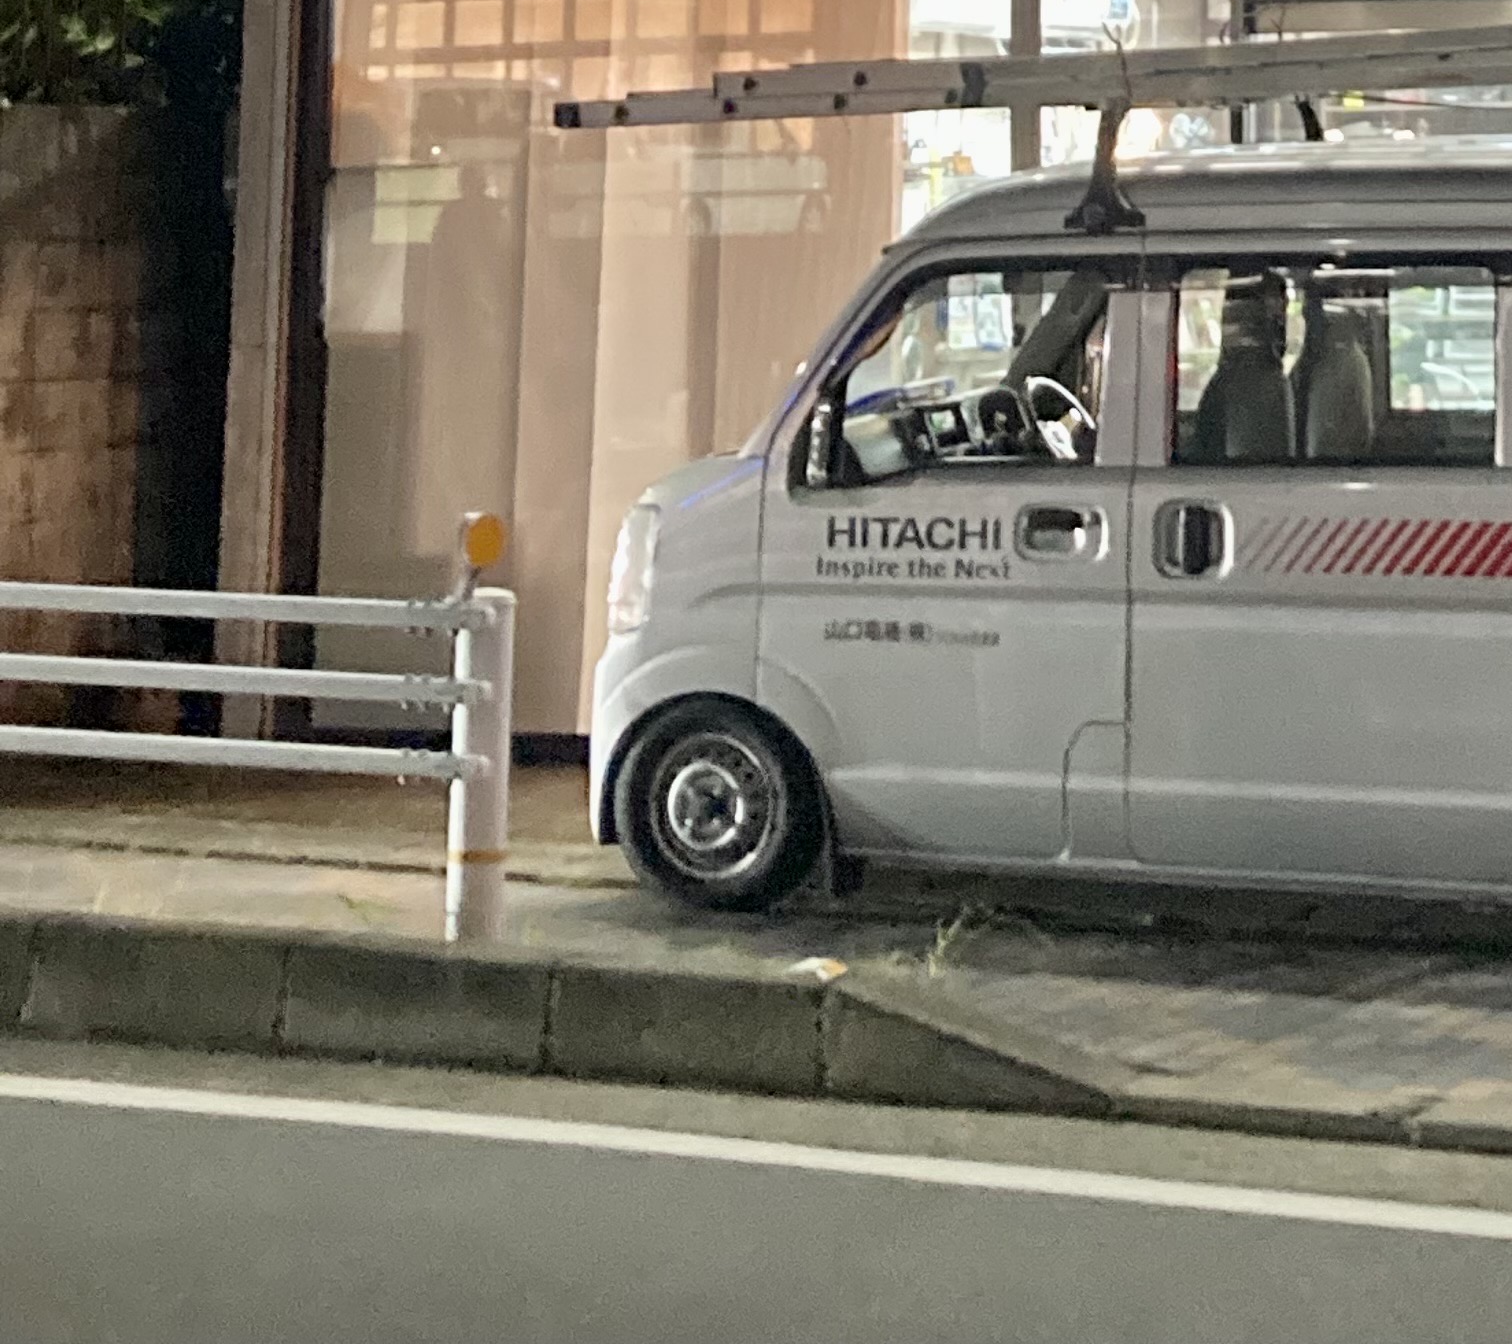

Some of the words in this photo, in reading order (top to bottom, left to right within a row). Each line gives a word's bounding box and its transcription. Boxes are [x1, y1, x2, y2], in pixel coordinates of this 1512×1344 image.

[827, 516, 1002, 551] HITACHI
[816, 554, 899, 581] Inspire
[906, 554, 946, 579] the
[953, 554, 1011, 580] Next
